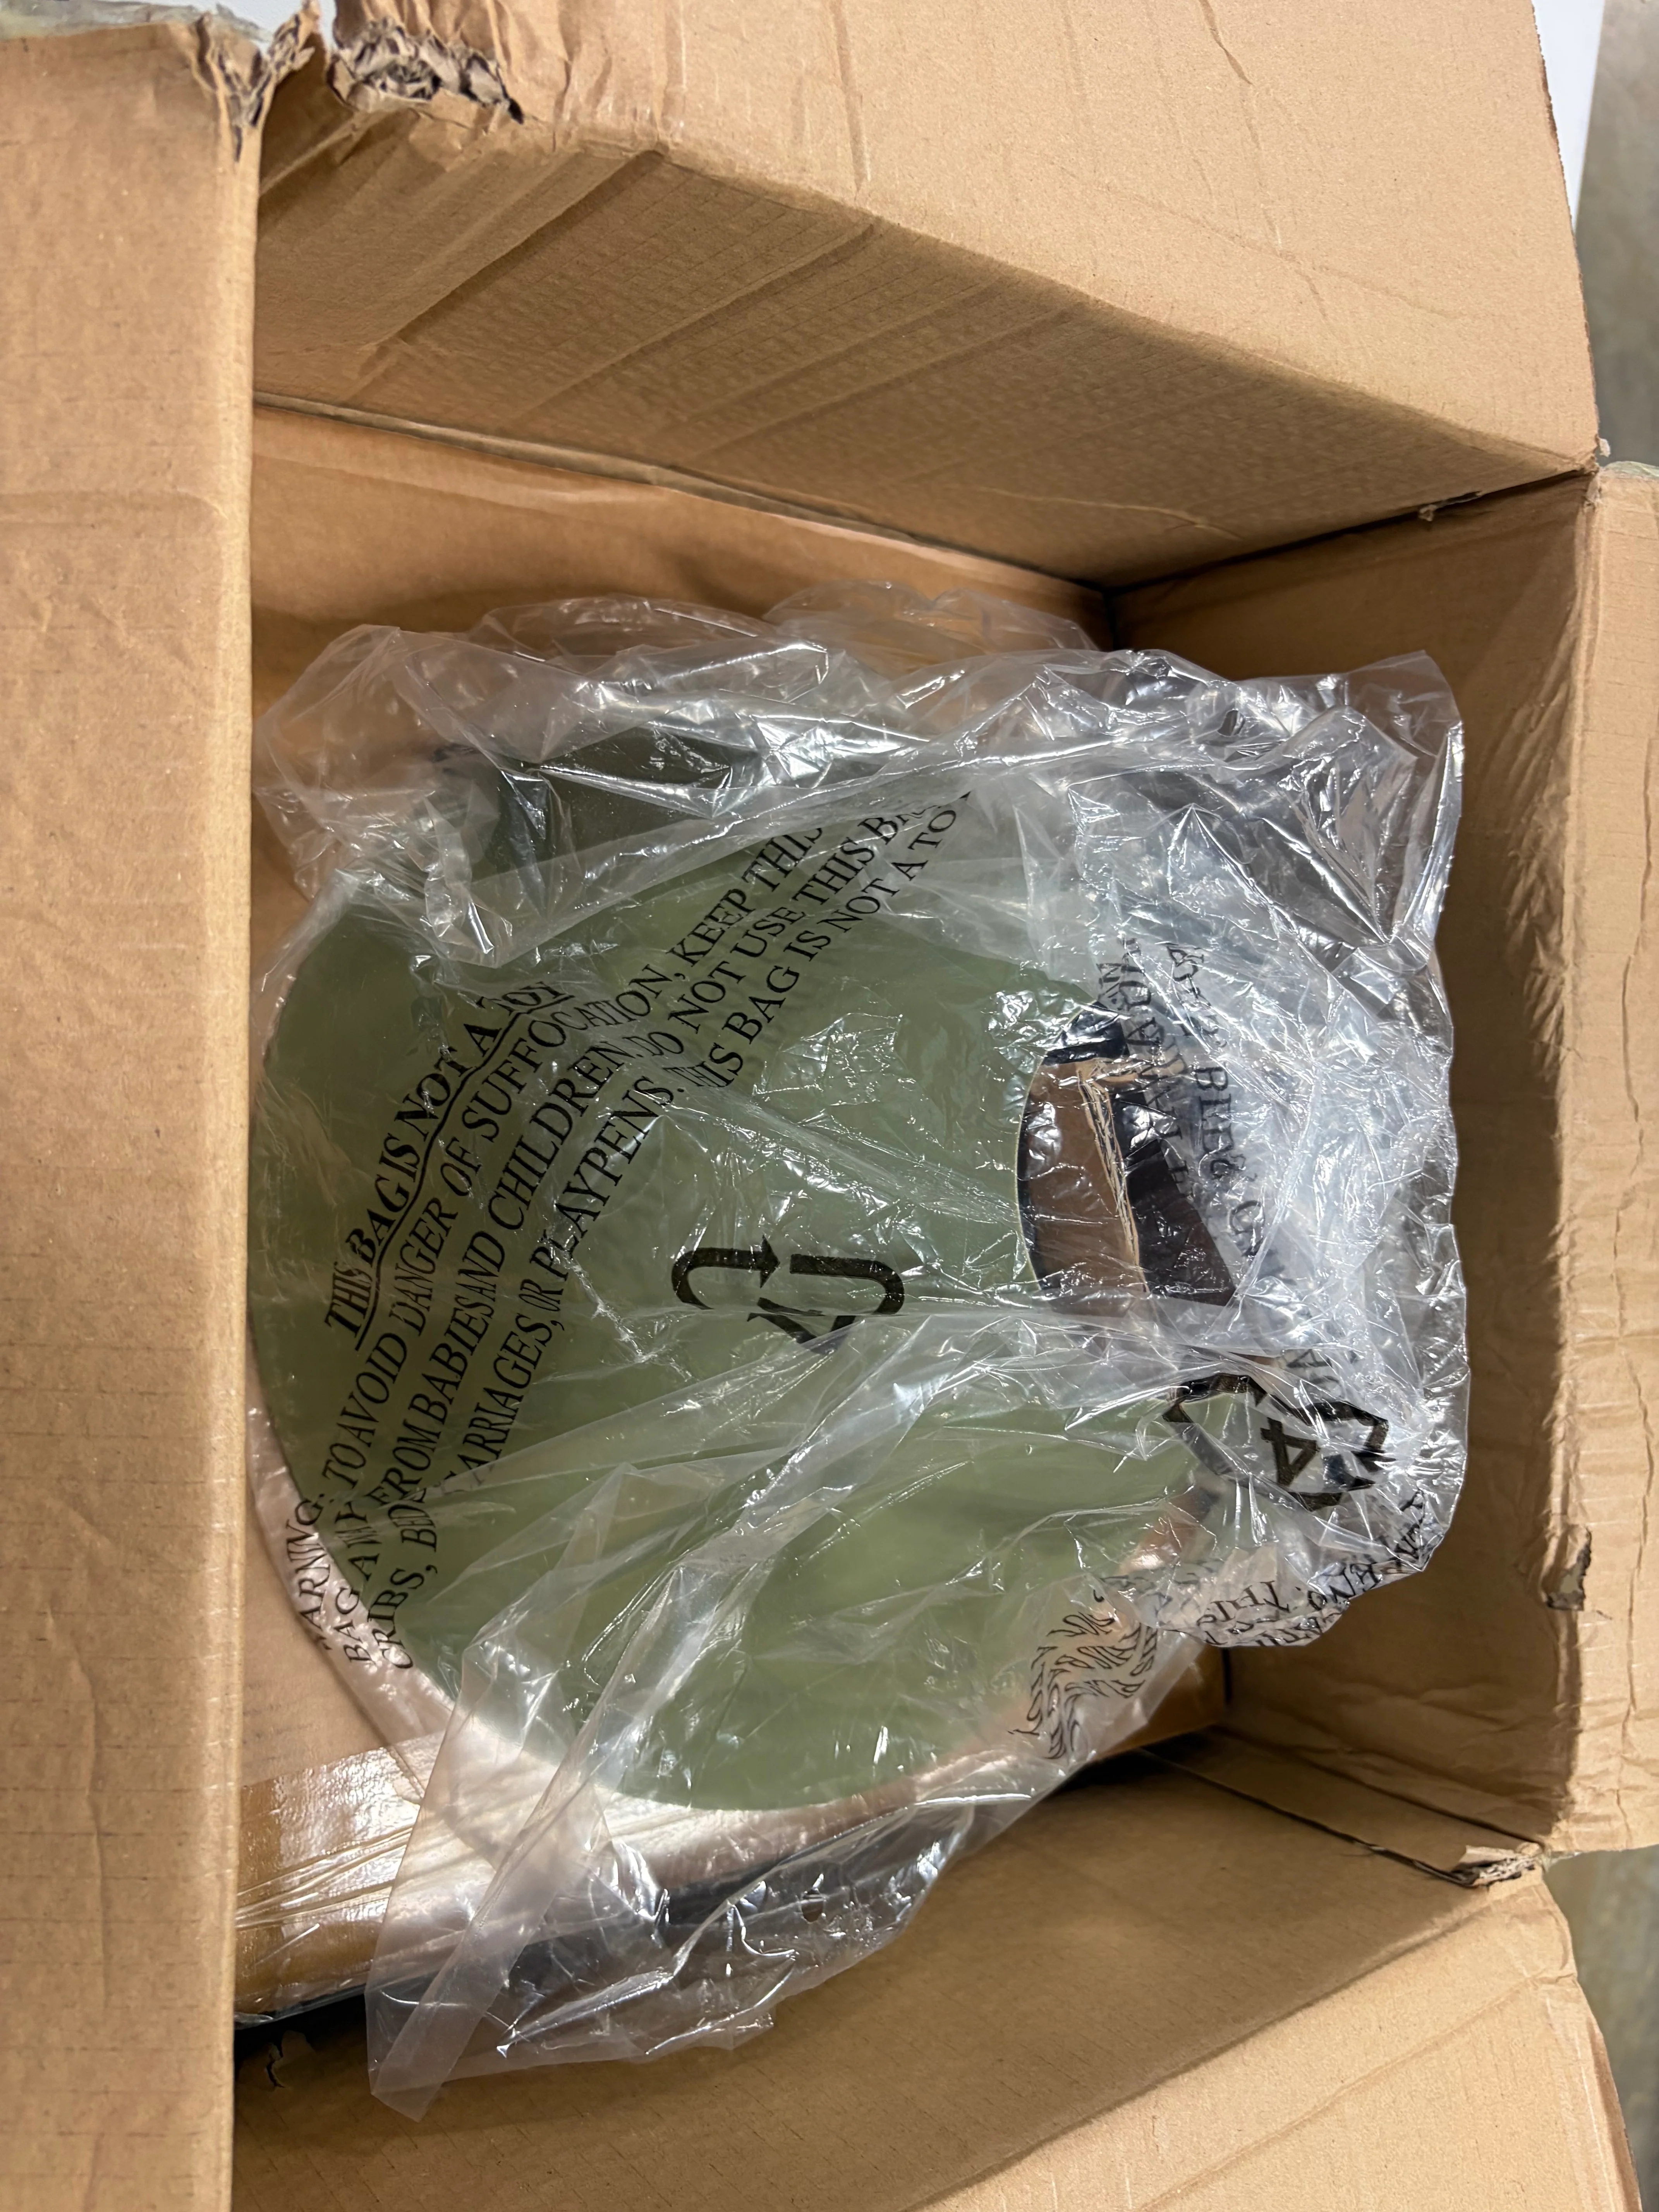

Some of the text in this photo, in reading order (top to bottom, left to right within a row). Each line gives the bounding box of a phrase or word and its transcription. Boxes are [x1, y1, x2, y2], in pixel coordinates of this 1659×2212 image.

[817, 878, 900, 933] NOT
[891, 860, 929, 881] A
[666, 888, 756, 967] KEEP
[783, 930, 831, 962] IS
[464, 1023, 502, 1058] A
[722, 965, 800, 1044] BAG
[462, 964, 686, 1142] SUFFOCATION,
[662, 1042, 744, 1088] THIS
[394, 1046, 475, 1142] NOT
[379, 1133, 421, 1182] IS
[440, 1137, 482, 1197] OF
[529, 1075, 685, 1282] PLAYPENS.
[333, 1586, 376, 1664] BAG
[364, 1419, 442, 1507] FROM
[409, 1294, 495, 1425] BABIES
[455, 1230, 506, 1302] AND
[488, 1041, 644, 1231] CHILDREN.
[622, 1031, 684, 1057] DO
[668, 960, 746, 1034] NOT
[730, 907, 805, 958] USE
[792, 836, 875, 905] THIS
[345, 1173, 410, 1267] BAG
[325, 1261, 372, 1338] THIS
[389, 1197, 459, 1336] DANGER
[518, 1278, 564, 1312] OR
[337, 1332, 407, 1447] AVOID
[443, 1313, 565, 1481] ARRIAGES,
[322, 1443, 366, 1489] TO
[1260, 1417, 1321, 1486] 4
[286, 1493, 334, 1650] ARNING:
[367, 1564, 438, 1669] CRIBS,
